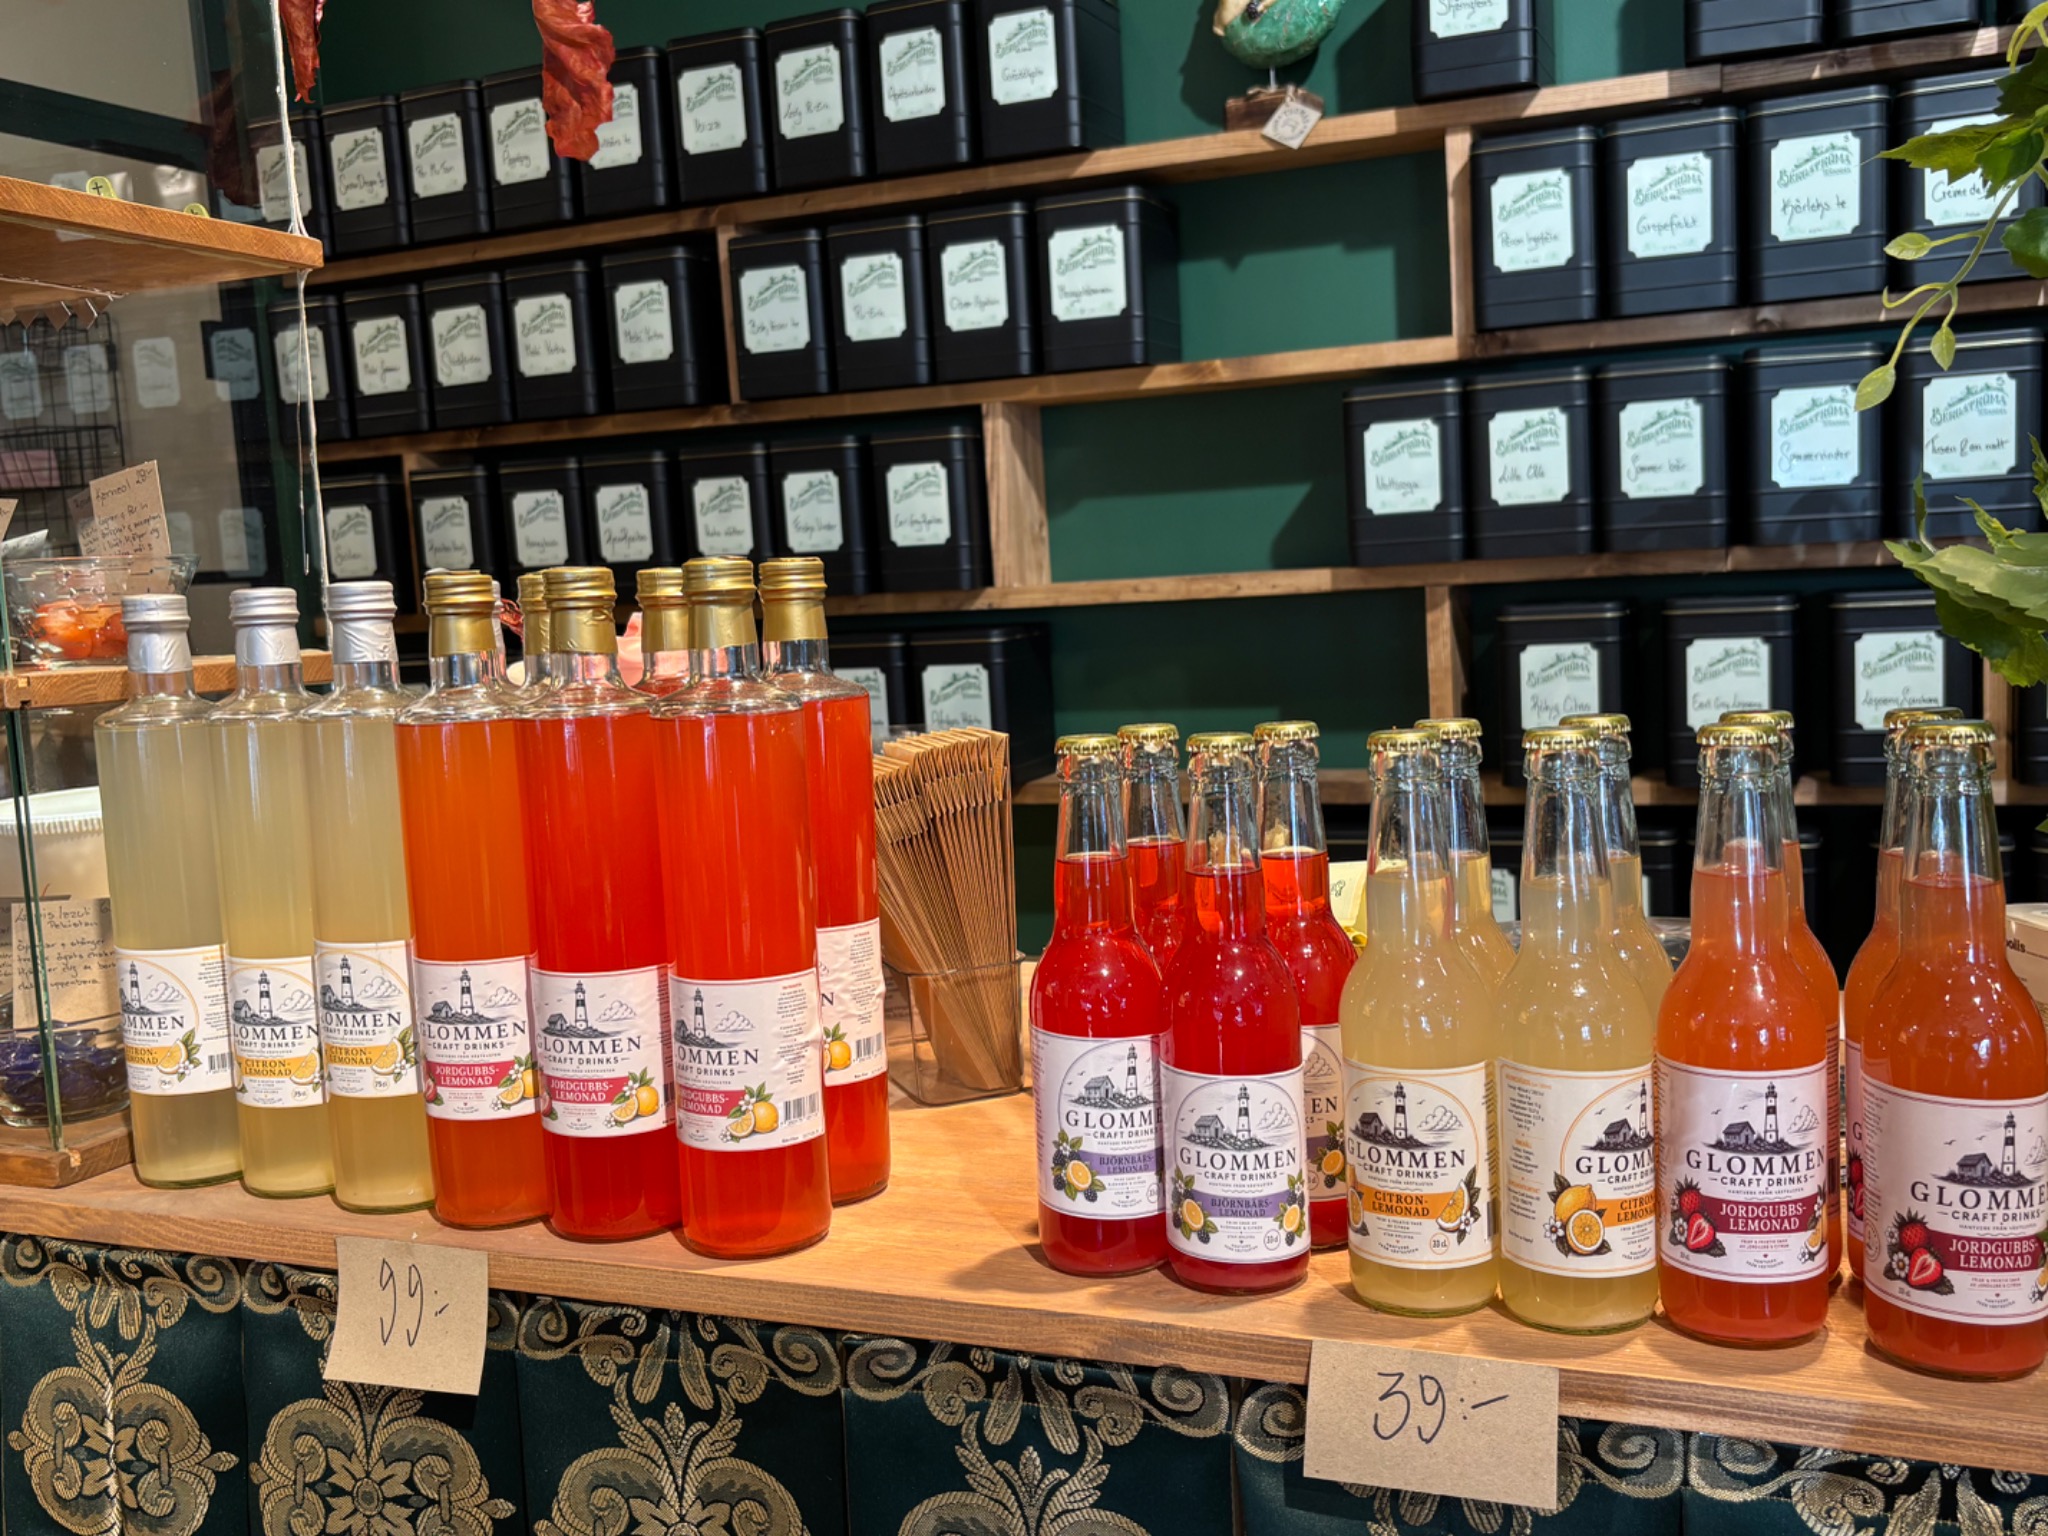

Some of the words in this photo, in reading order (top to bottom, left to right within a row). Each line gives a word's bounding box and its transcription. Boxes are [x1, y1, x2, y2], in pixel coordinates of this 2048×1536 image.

[234, 1024, 320, 1041] LOMMEN
[344, 1028, 377, 1037] DRINKS
[261, 1041, 297, 1049] DRINKS
[432, 1042, 459, 1051] CRAFT
[464, 1041, 505, 1051] DRINKS
[548, 1056, 573, 1066] CRAFT
[578, 1057, 619, 1066] DRINKS
[244, 1066, 292, 1077] LEMONAD
[436, 1064, 500, 1075] JORDGUBBS-
[696, 1068, 735, 1077] DRINKS
[440, 1076, 493, 1086] LEMONAD
[551, 1080, 614, 1091] JORDGUBBS-
[555, 1090, 606, 1102] LEMONAD
[1093, 1130, 1125, 1140] CRAFT
[1180, 1147, 1297, 1171] GLOMMEN
[1348, 1137, 1466, 1169] GLOMMEN
[1686, 1145, 1825, 1176] GLOMMEN
[1106, 1165, 1150, 1175] LEMONAD
[1204, 1171, 1236, 1180] CRAFT
[1240, 1172, 1277, 1182] DRINKS
[1363, 1163, 1392, 1176] CRAFT
[1397, 1170, 1439, 1180] DRINKS
[1608, 1172, 1637, 1184] CRAFT
[1720, 1177, 1761, 1188] CRAFT
[1767, 1174, 1809, 1187] DRINKS
[1211, 1196, 1273, 1209] BJÖRNBÄRS-
[1374, 1191, 1429, 1206] CITRON-
[1910, 1181, 2048, 1211] GLOMME
[1220, 1207, 1266, 1217] LEMONAD
[1372, 1204, 1431, 1218] LEMONAD
[1720, 1203, 1807, 1217] JORDGUBBS-
[1951, 1210, 1996, 1223] CRAFT
[2002, 1209, 2041, 1222] DRINKS
[1729, 1217, 1800, 1232] LEMONAD
[1950, 1238, 2039, 1255] JORDGUBBS-
[1959, 1255, 2032, 1269] LEMONAD
[380, 1257, 449, 1348] 99:-
[1373, 1372, 1510, 1445] 39:-
